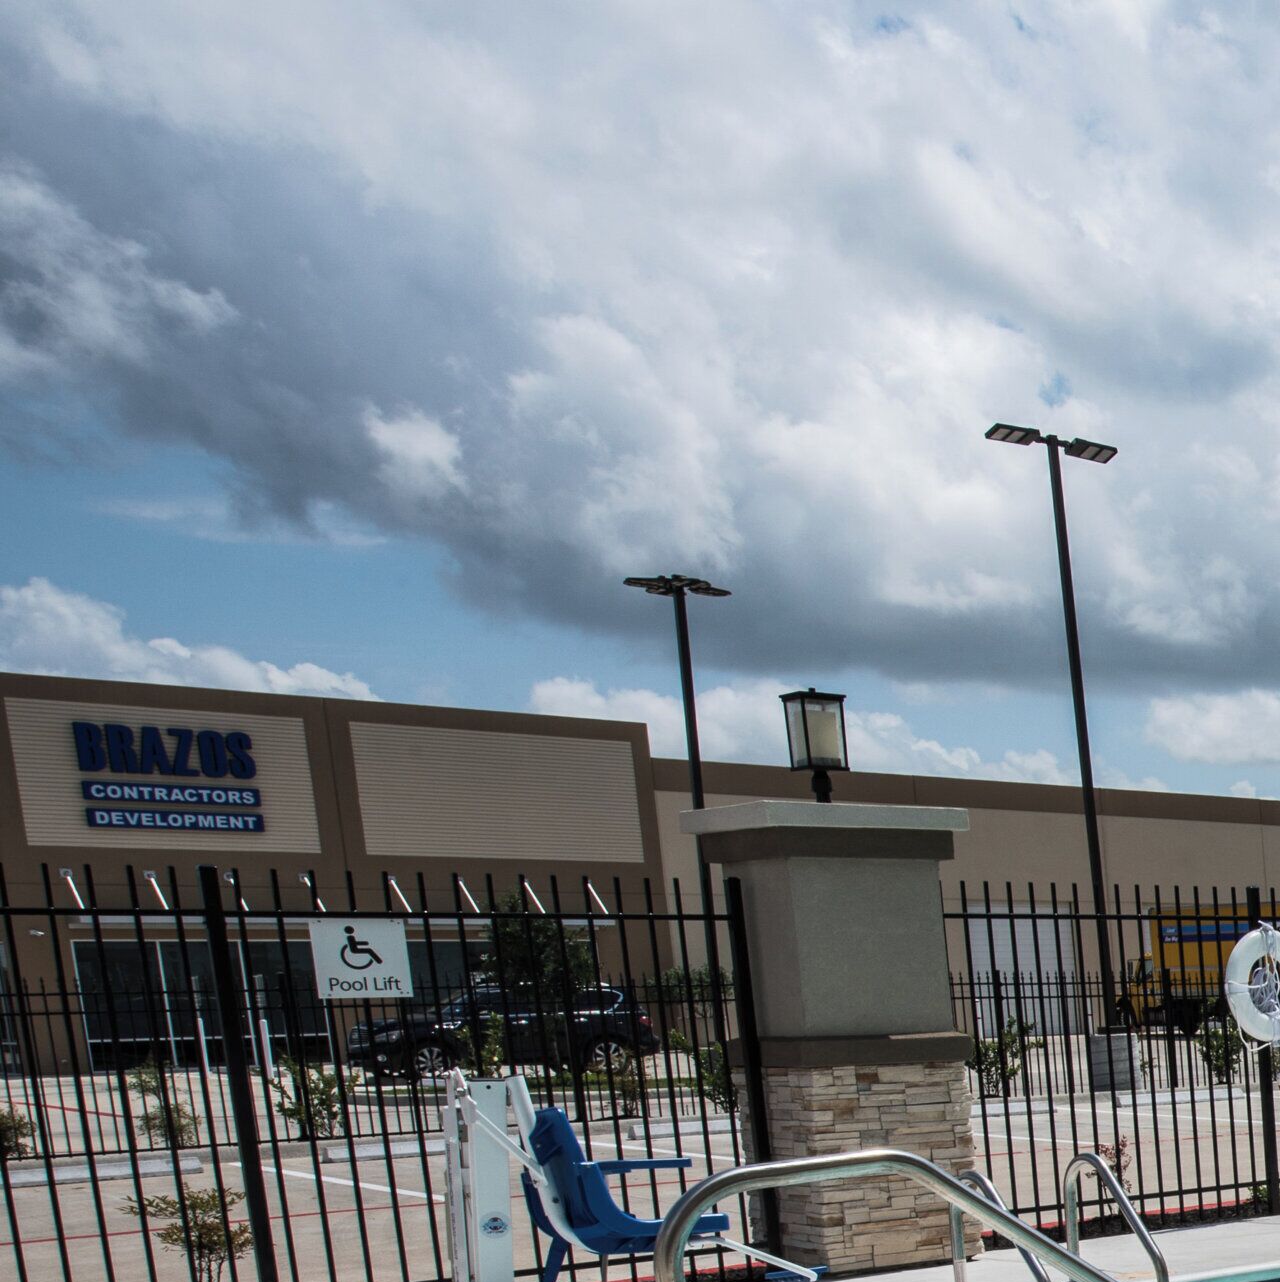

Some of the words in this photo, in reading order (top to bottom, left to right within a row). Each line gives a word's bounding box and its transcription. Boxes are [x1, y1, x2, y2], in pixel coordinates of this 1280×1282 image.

[72, 721, 257, 780] BRAZOS
[90, 784, 255, 805] CONTRACTORS
[94, 811, 257, 830] DEVELOPMENT
[329, 976, 368, 992] Pool
[373, 976, 402, 991] Lift
